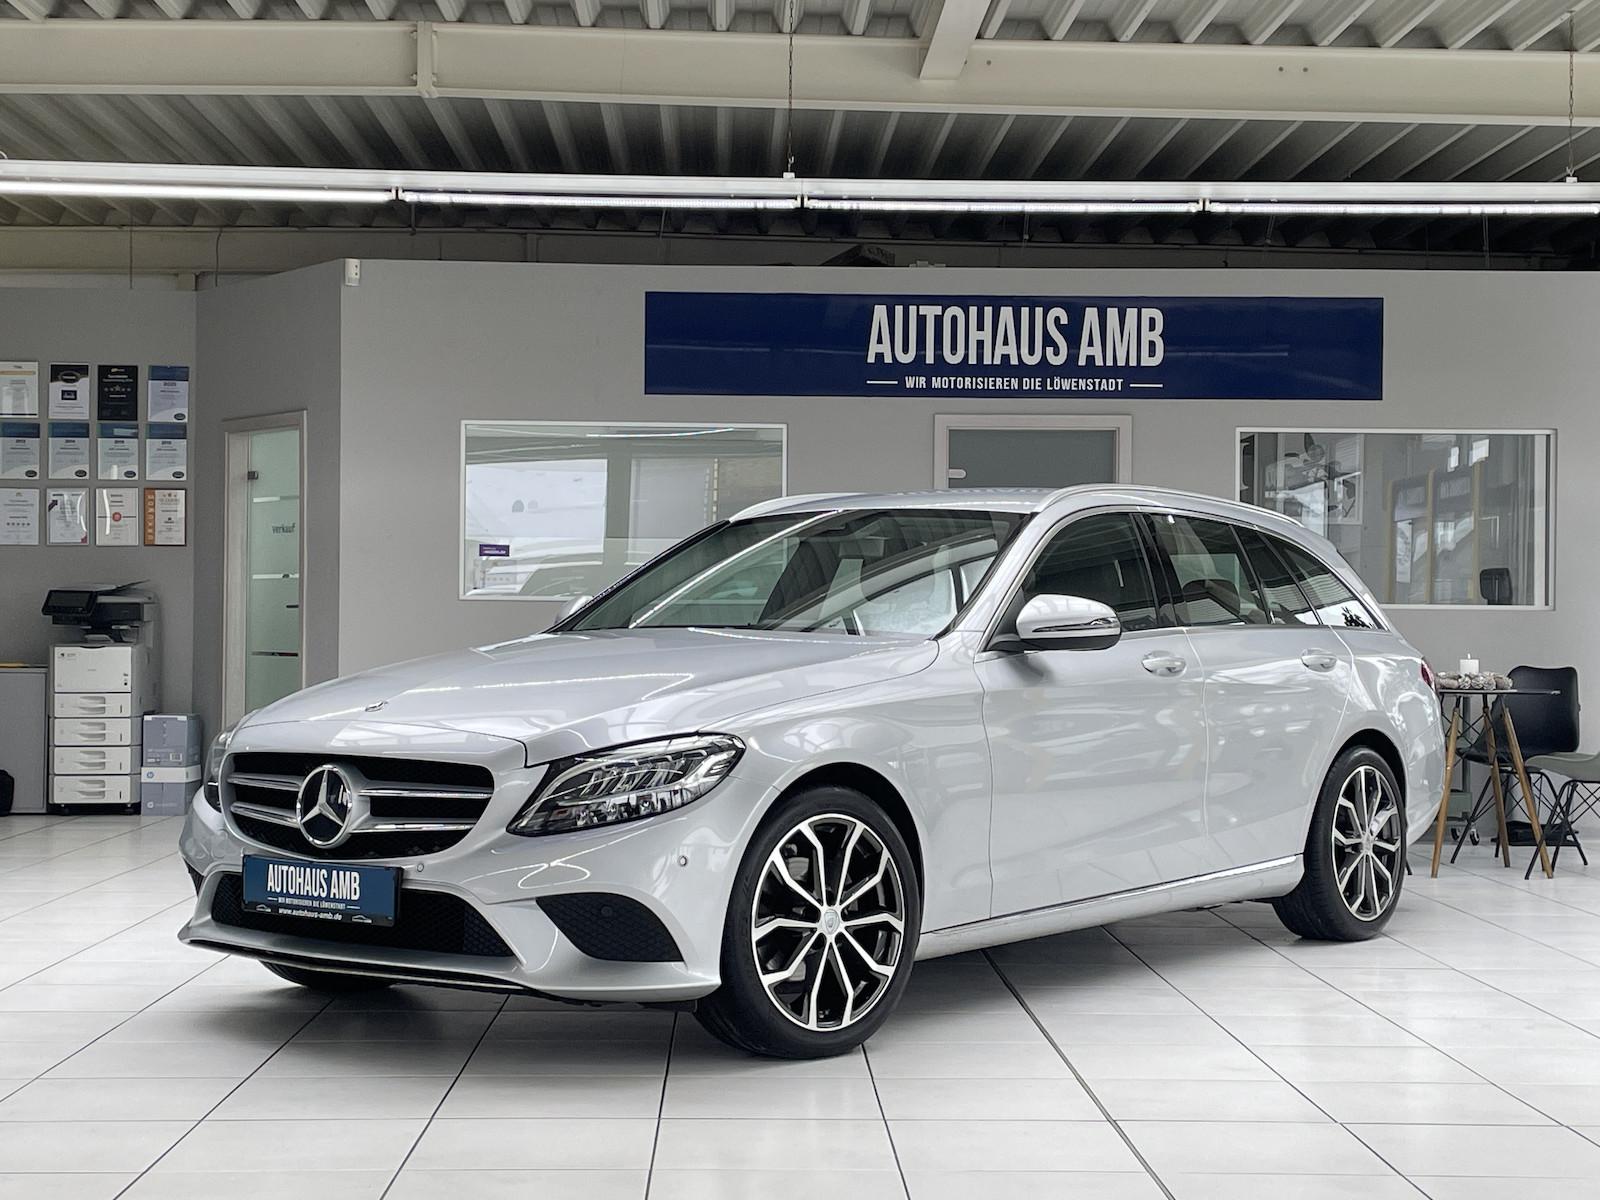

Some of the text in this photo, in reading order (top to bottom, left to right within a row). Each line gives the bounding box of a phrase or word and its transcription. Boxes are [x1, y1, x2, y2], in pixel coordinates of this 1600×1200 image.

[866, 304, 1164, 367] AUTOHAUS AMB
[905, 376, 1124, 391] WIR MOTORISIEREN DIE LÖWENSTADT
[267, 863, 360, 900] AUTOHAUS AMB
